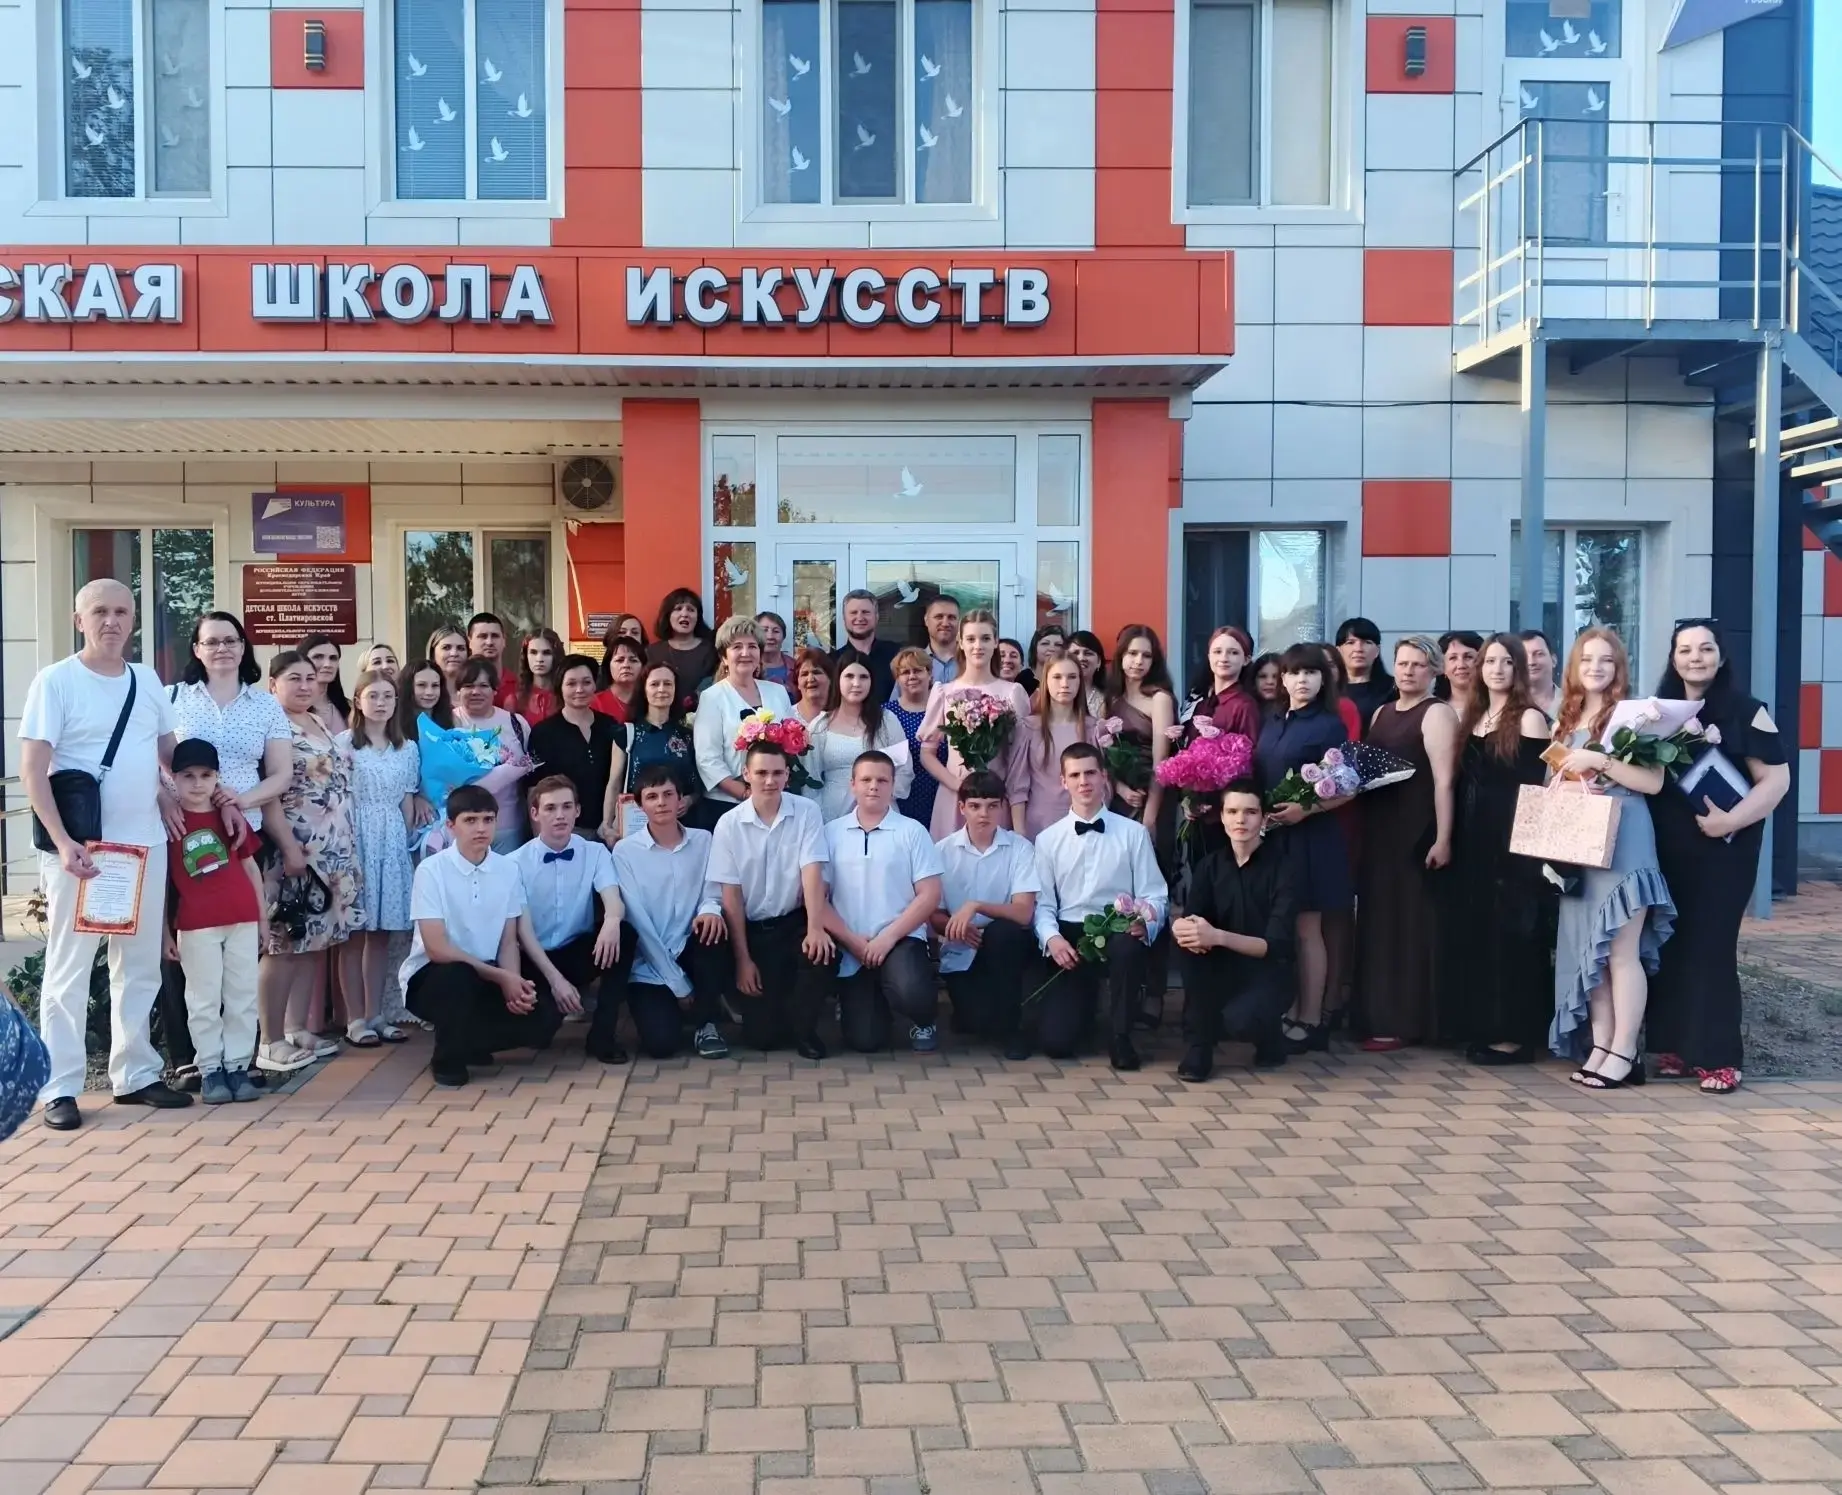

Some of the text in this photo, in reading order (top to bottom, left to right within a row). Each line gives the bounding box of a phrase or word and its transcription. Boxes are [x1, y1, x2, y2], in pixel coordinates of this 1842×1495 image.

[251, 263, 553, 324] ШКОЛА
[625, 266, 1051, 328] ИСКУССТВ
[245, 604, 338, 613] ДЕТСКАЯ ШКОЛА ИСКУССТВ
